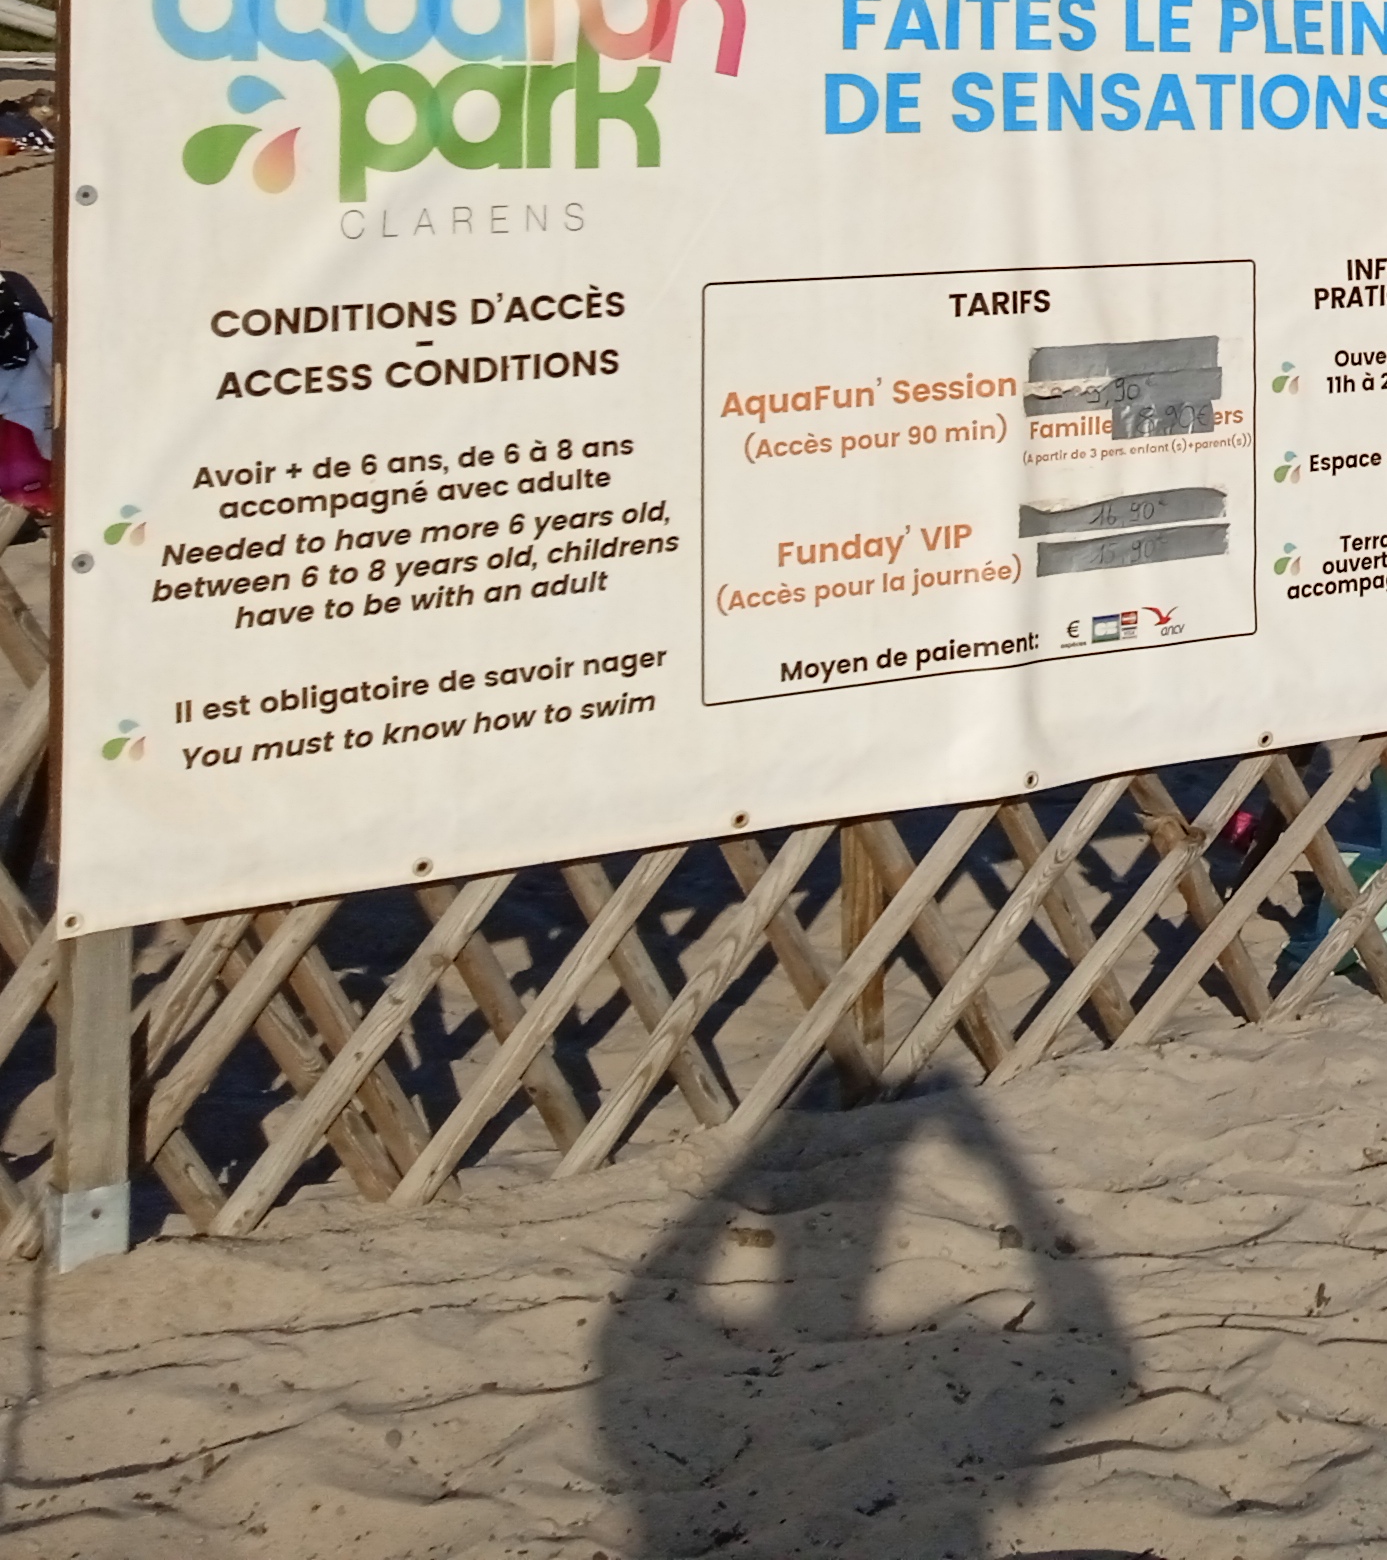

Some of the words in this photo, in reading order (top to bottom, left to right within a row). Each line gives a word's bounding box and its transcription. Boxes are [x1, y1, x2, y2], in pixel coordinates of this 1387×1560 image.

[338, 28, 661, 202] park
[825, 72, 921, 134] DE
[341, 201, 586, 240] CLARENS
[211, 300, 457, 338] CONDITIONS
[949, 289, 1050, 317] TARIFS
[216, 364, 372, 400] ACCESS
[385, 349, 619, 388] CONDITIONS
[893, 373, 1016, 404] Session
[1327, 374, 1355, 394] 11h
[1362, 372, 1374, 391] à
[744, 432, 832, 464] (Accès
[841, 432, 900, 458] pour
[908, 425, 937, 445] 90
[945, 413, 1007, 443] min)
[1030, 415, 1112, 440] Famille
[1213, 408, 1243, 425] ers
[192, 461, 276, 489] Avoir
[286, 463, 302, 479] +
[313, 457, 351, 479] de
[361, 454, 377, 475] 6
[387, 454, 449, 475] ans,
[458, 446, 495, 468] de
[504, 443, 520, 464] 6
[529, 439, 547, 462] à
[557, 439, 573, 460] 8
[582, 439, 634, 458] ans
[1035, 447, 1066, 463] partir
[1071, 447, 1086, 460] de
[1089, 448, 1097, 457] 3
[1100, 445, 1126, 461] pers.
[1129, 442, 1168, 455] enfant
[1310, 452, 1382, 476] Espace
[219, 480, 428, 519] accompagné
[437, 480, 509, 501] avec
[517, 468, 611, 494] adulte
[161, 534, 287, 567] Needed
[296, 533, 326, 554] to
[335, 529, 412, 551] have
[420, 521, 500, 543] more
[509, 513, 525, 535] 6
[533, 510, 614, 541] years
[621, 500, 670, 526] old,
[921, 524, 972, 551] VIP
[152, 573, 290, 603] between
[301, 565, 319, 588] 6
[329, 564, 359, 585] to
[368, 559, 386, 582] 8
[394, 555, 478, 586] years
[486, 544, 537, 571] old,
[547, 536, 680, 564] childrens
[717, 583, 806, 616] (Accès
[815, 579, 875, 607] pour
[883, 573, 905, 593] la
[912, 554, 1021, 596] journée)
[235, 605, 315, 629] have
[325, 599, 354, 620] to
[363, 593, 401, 616] be
[411, 584, 474, 611] with
[484, 584, 522, 603] an
[531, 571, 608, 598] adult
[1066, 619, 1080, 639] €
[781, 656, 868, 684] Moyen
[876, 648, 908, 669] de
[916, 632, 1039, 671] paiement:
[176, 700, 192, 724] Il
[202, 695, 250, 720] est
[260, 675, 429, 714] obligatoire
[438, 670, 475, 693] de
[484, 656, 575, 687] savoir
[583, 650, 667, 678] nager
[182, 746, 242, 770] You
[251, 731, 335, 761] must
[344, 729, 373, 750] to
[382, 719, 467, 745] know
[473, 710, 537, 734] how
[544, 704, 572, 724] to
[580, 692, 656, 719] swim
